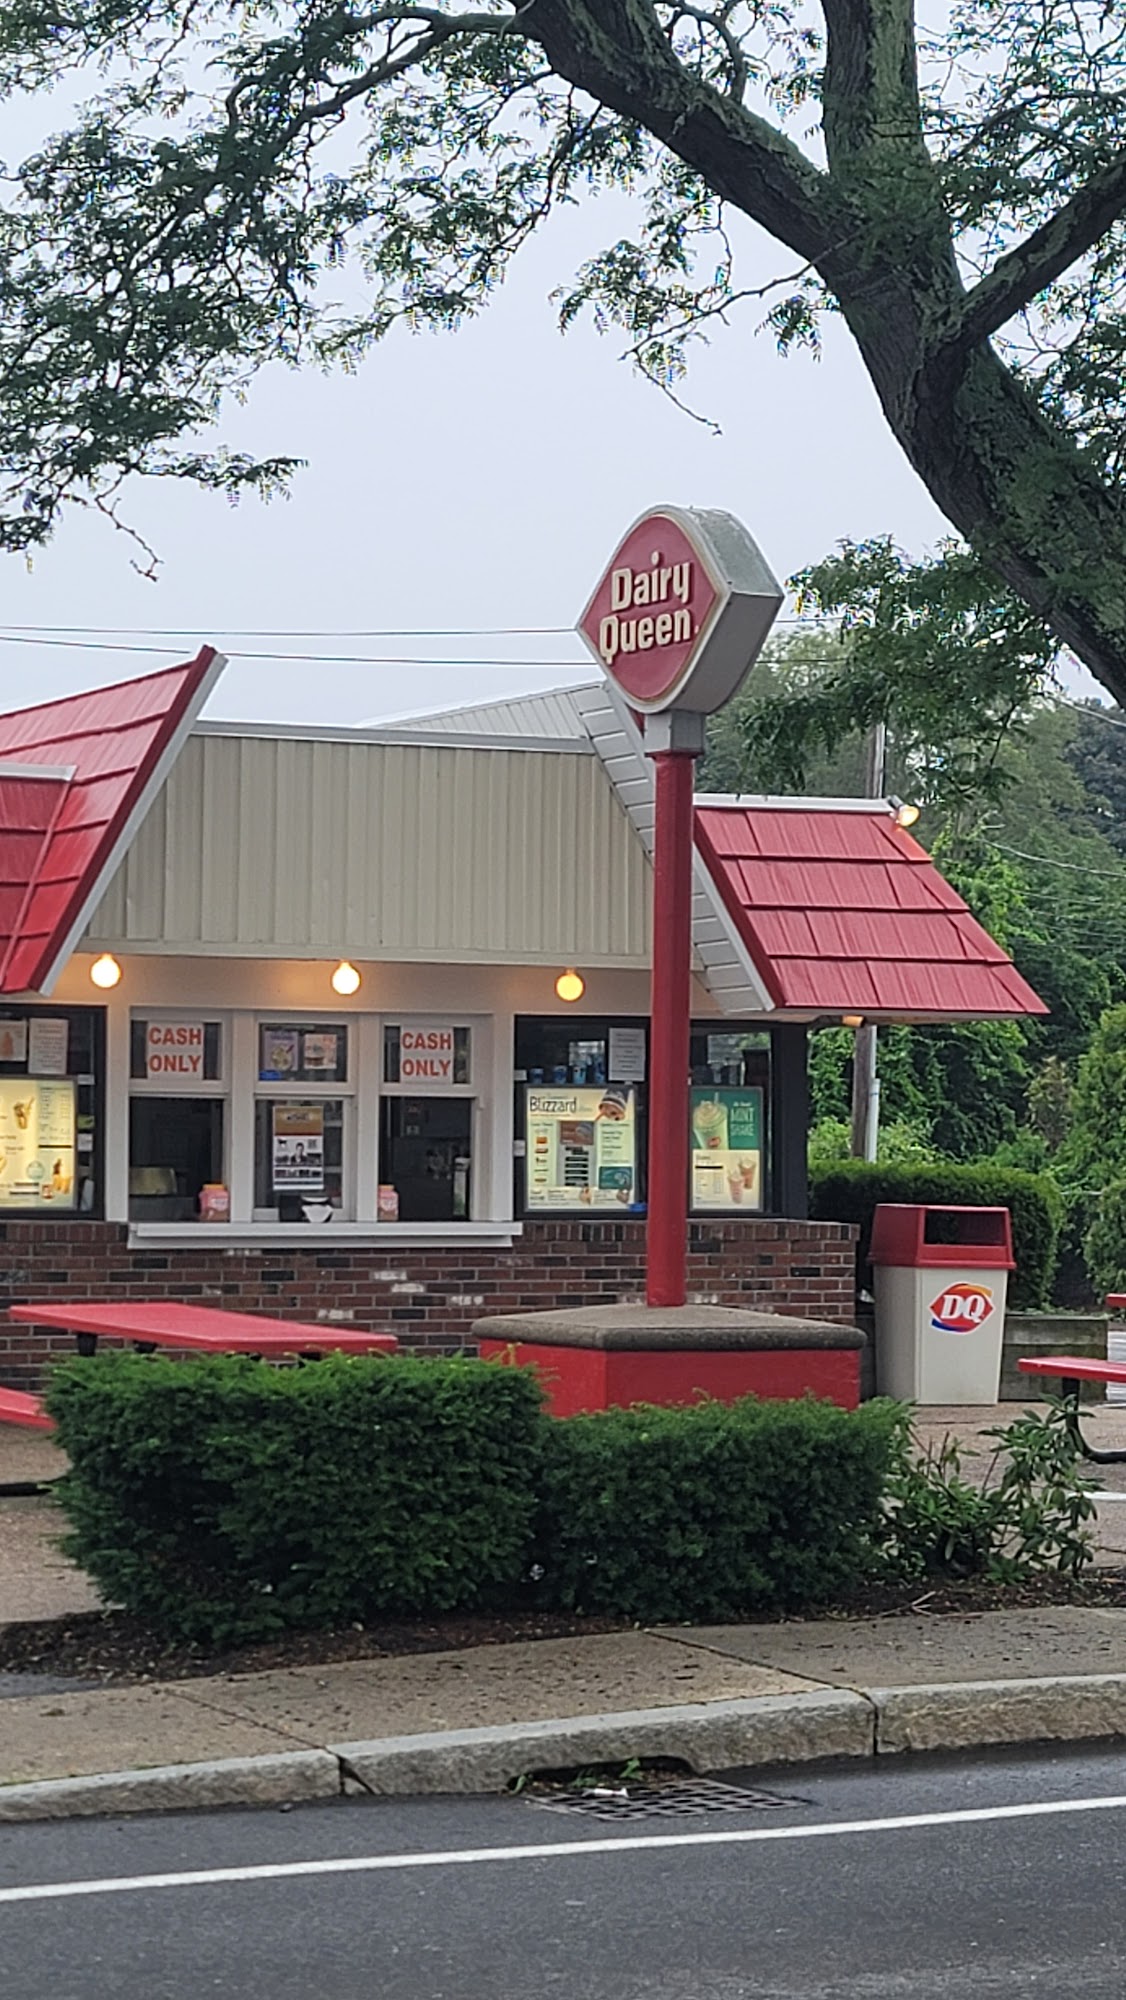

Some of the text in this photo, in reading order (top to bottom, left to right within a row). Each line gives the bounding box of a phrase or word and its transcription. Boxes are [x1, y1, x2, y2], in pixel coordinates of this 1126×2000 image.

[611, 551, 691, 611] Dairy
[599, 608, 691, 664] Queen
[148, 1027, 203, 1046] CASH
[401, 1032, 452, 1050] CASH
[148, 1054, 202, 1072] ONLY
[402, 1058, 452, 1076] ONLY
[530, 1096, 577, 1114] Blizzard
[940, 1294, 986, 1323] DQ
